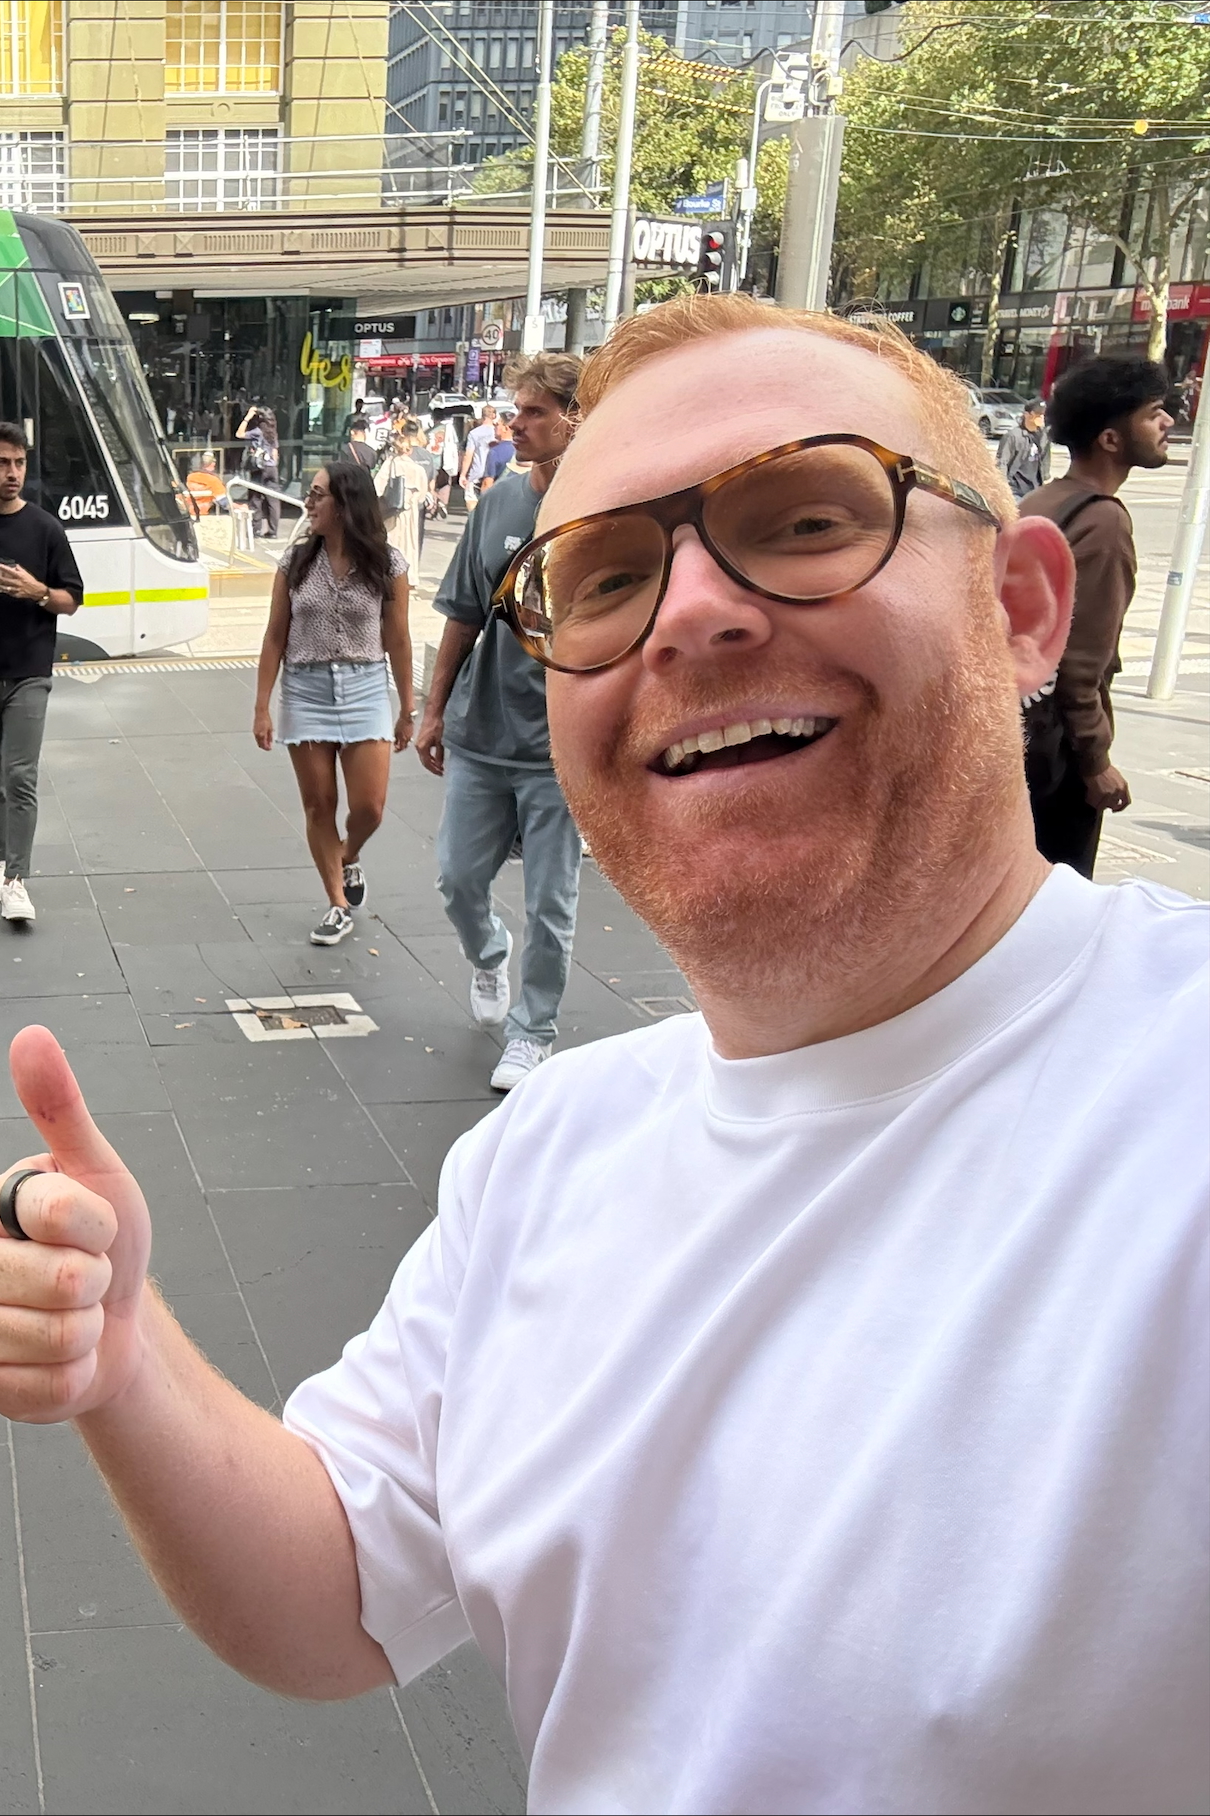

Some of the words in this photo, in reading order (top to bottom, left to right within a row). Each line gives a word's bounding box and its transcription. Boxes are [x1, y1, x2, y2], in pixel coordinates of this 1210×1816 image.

[683, 199, 710, 208] Bourke
[633, 219, 702, 264] OPTUS
[888, 311, 915, 322] COFFEE
[354, 322, 395, 333] OPTUS
[484, 328, 499, 340] 40
[57, 494, 110, 521] 6045
